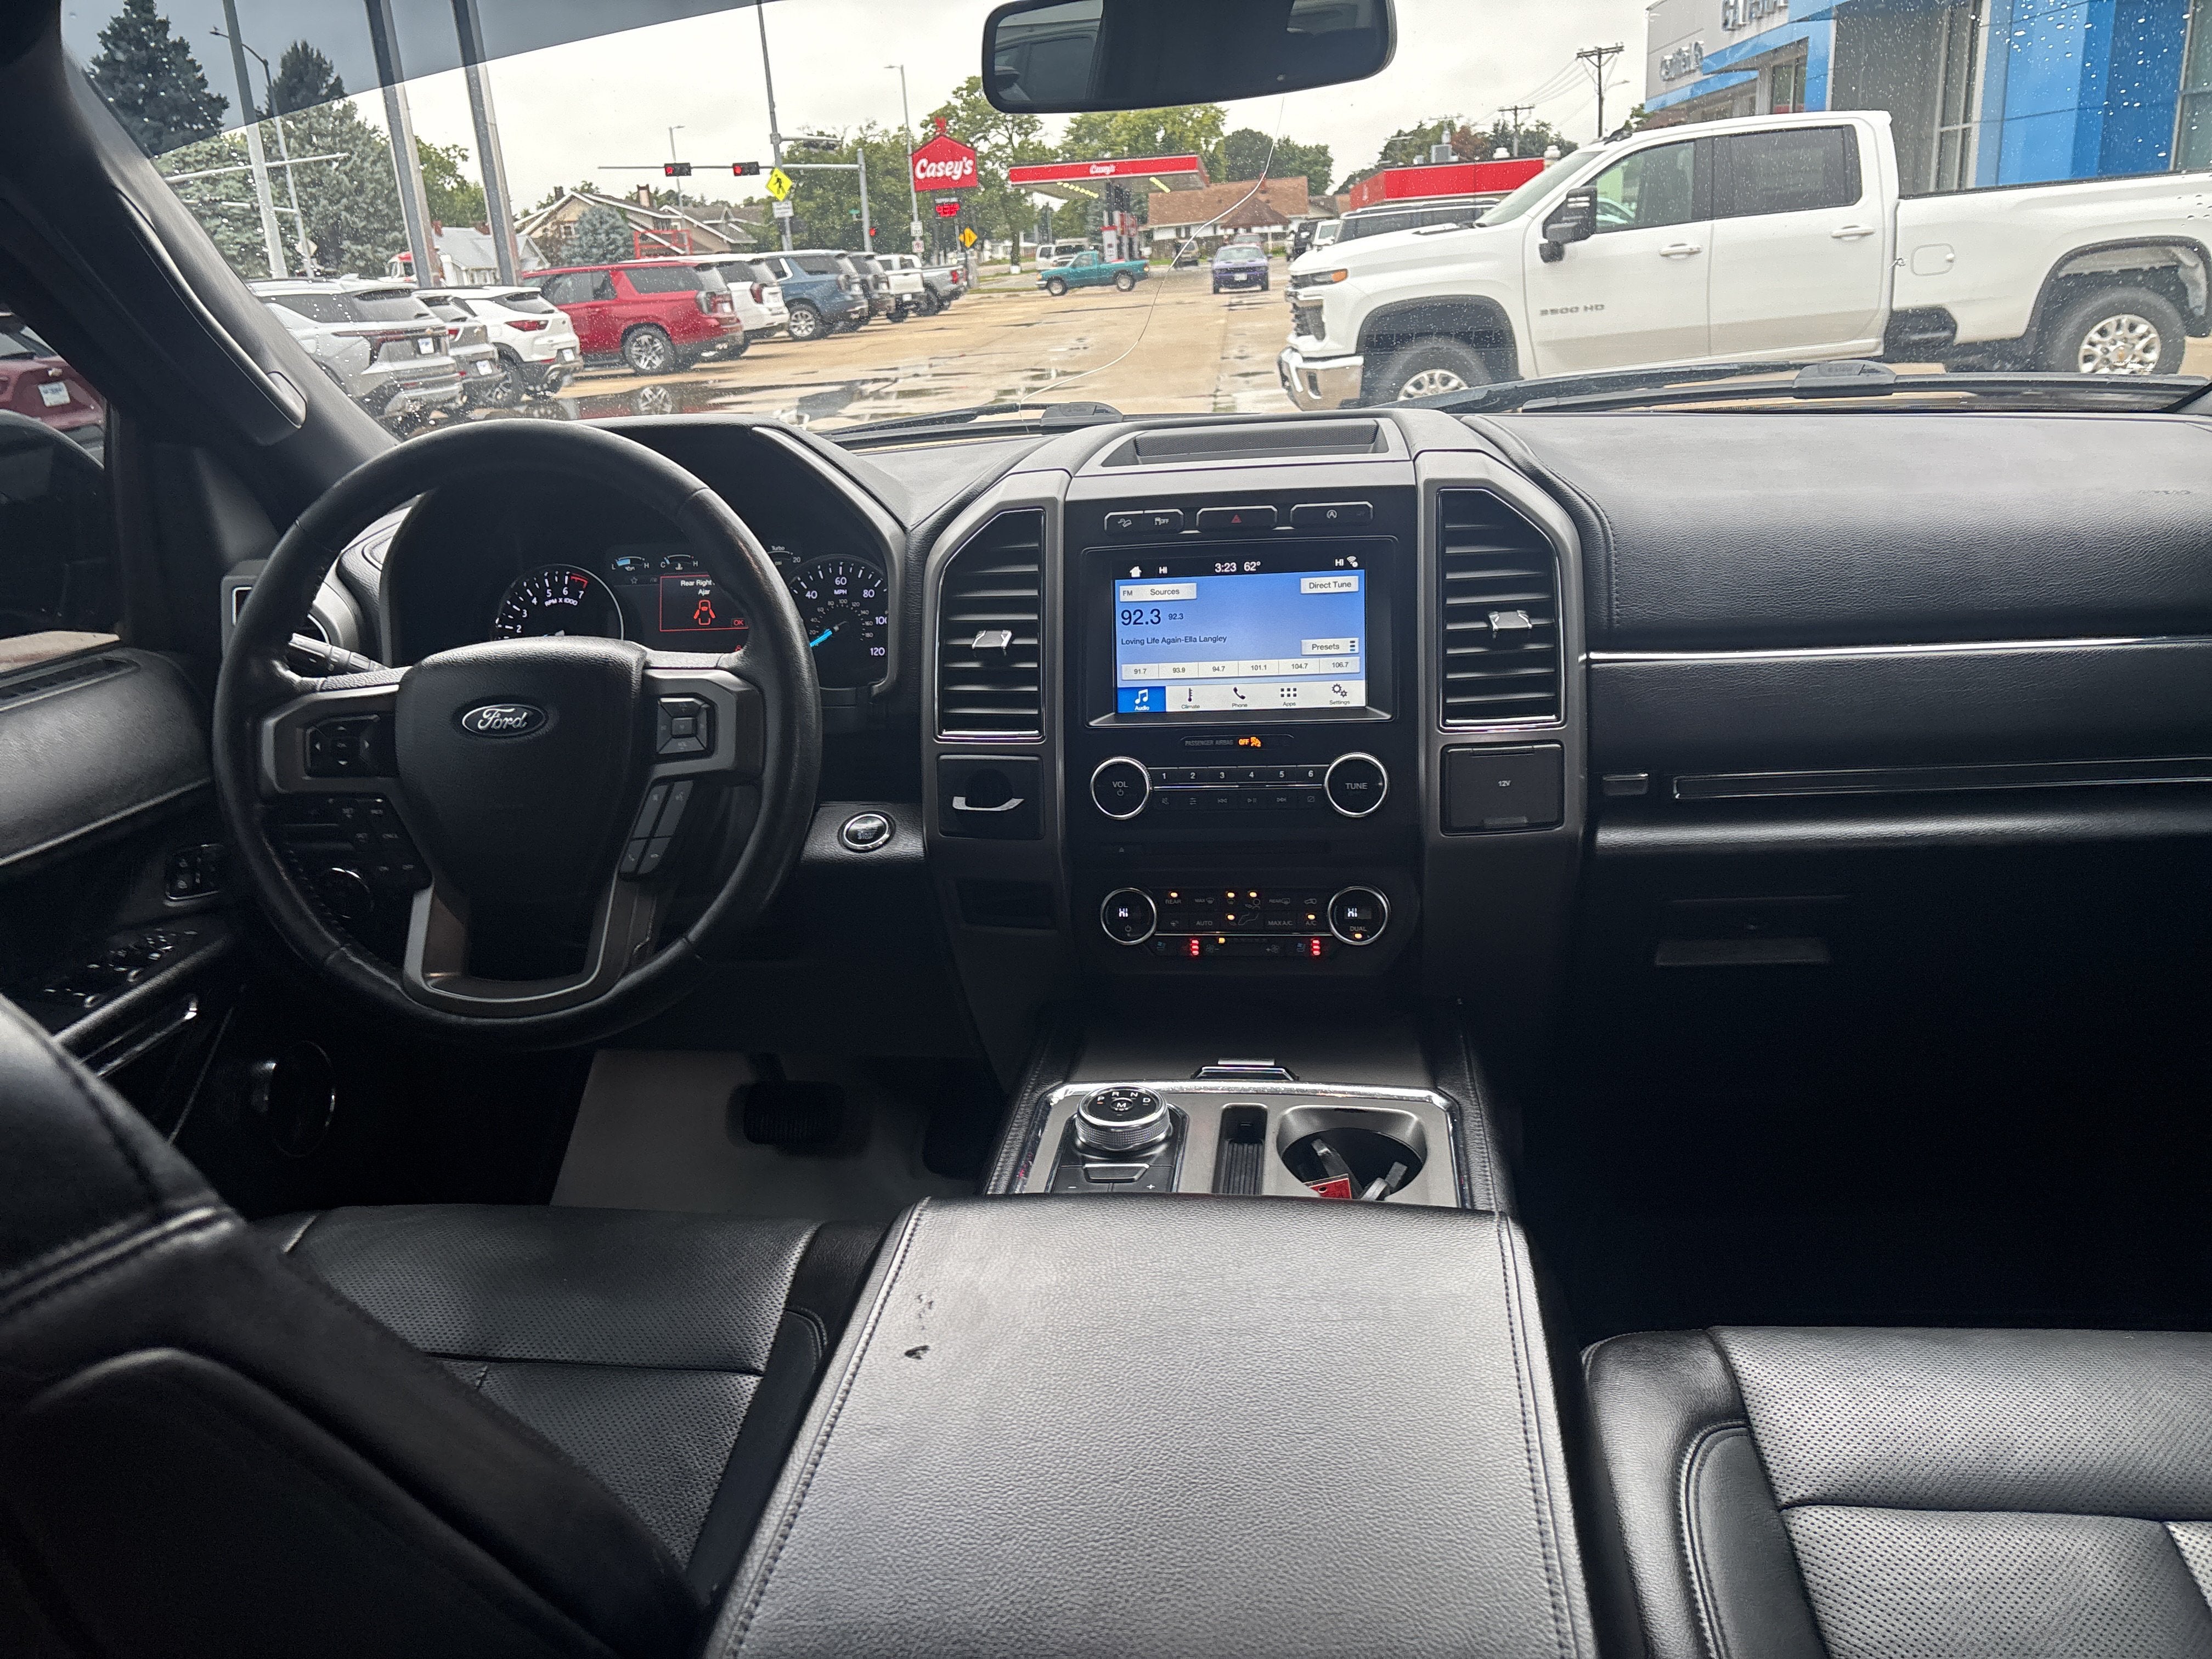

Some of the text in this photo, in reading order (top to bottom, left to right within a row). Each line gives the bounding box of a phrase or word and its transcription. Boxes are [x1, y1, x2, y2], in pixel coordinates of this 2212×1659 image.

[915, 156, 973, 180] Casey's
[1335, 558, 1344, 567] HI
[1159, 566, 1167, 574] HI
[1215, 562, 1237, 573] 3:23
[835, 577, 847, 585] 60
[546, 589, 552, 597] 5
[562, 586, 568, 595] 6
[578, 590, 584, 599] 7
[805, 590, 817, 599] 40
[863, 589, 875, 598] 80
[532, 597, 538, 605] 4
[564, 597, 578, 606] 1000
[522, 609, 527, 617] 3
[1121, 608, 1161, 625] 92.3
[516, 624, 522, 633] 2
[1161, 636, 1197, 645] Again-Ella
[1199, 635, 1227, 644] Langley
[871, 647, 885, 656] 120
[478, 708, 528, 730] Ford
